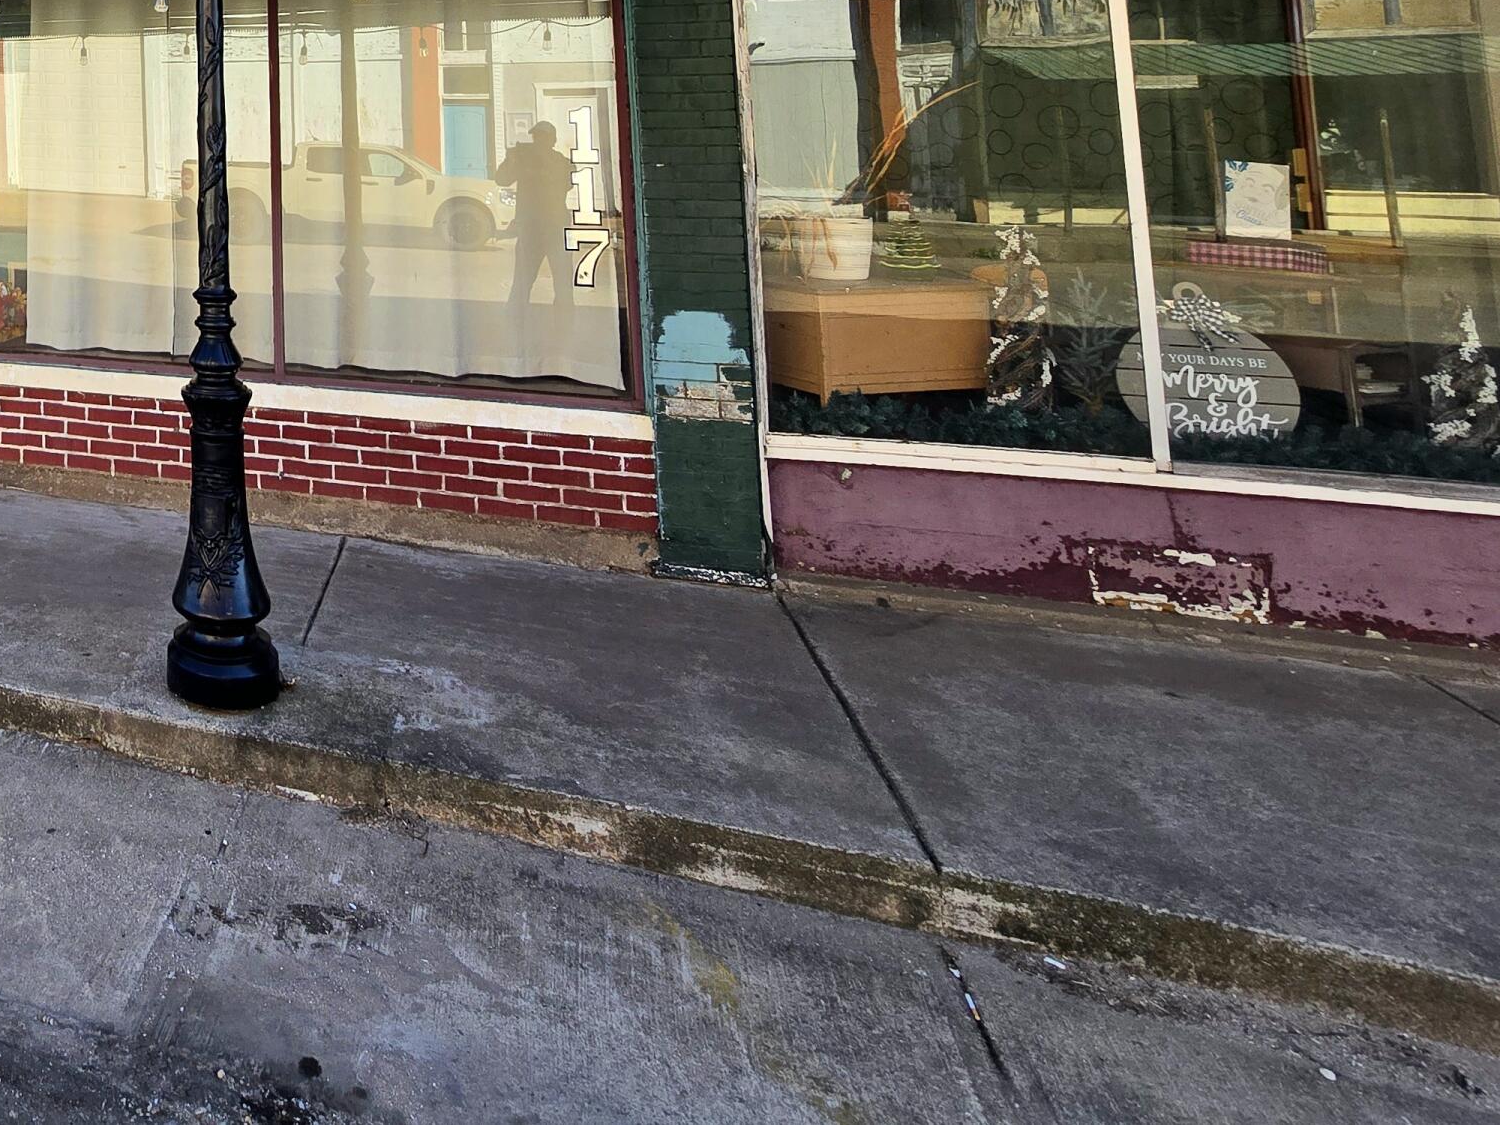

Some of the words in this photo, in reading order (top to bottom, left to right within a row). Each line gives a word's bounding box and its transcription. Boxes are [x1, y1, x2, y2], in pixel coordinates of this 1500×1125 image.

[1169, 352, 1206, 365] YOUR
[1209, 356, 1245, 367] DAYS
[1248, 358, 1268, 369] BE
[1161, 364, 1260, 408] Merry
[1206, 392, 1229, 416] &
